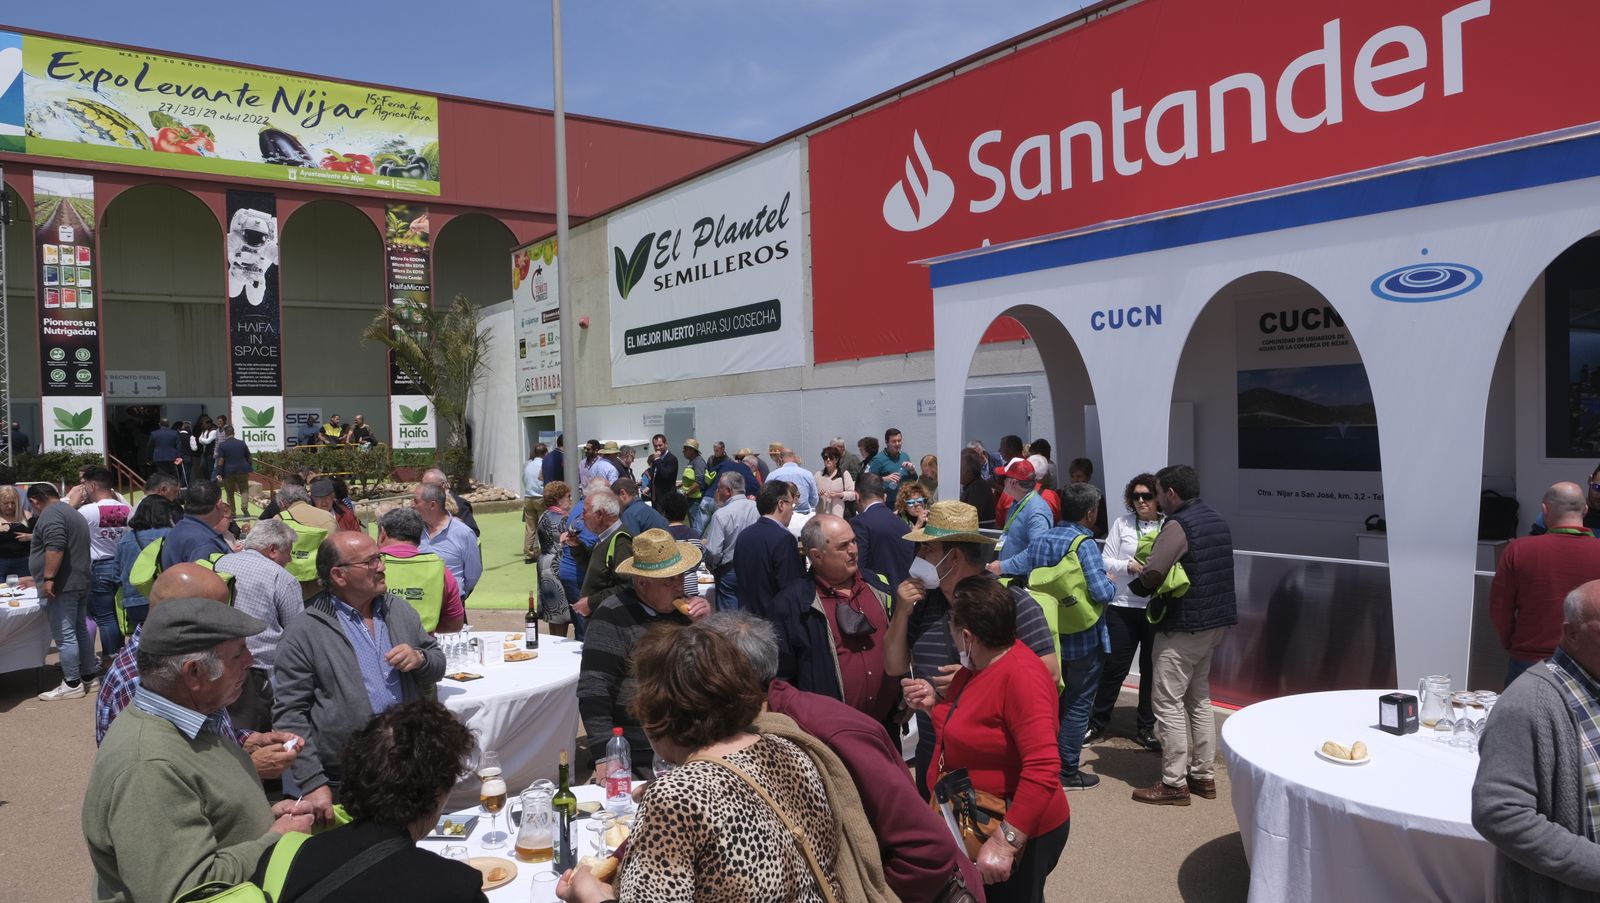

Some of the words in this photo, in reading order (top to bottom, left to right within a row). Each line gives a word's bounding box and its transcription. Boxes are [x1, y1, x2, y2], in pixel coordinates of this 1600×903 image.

[382, 96, 407, 109] Feria
[409, 101, 421, 111] de
[968, 0, 1491, 214] Santander
[219, 112, 241, 121] abril
[242, 113, 270, 126] 2022
[372, 104, 432, 122] Agricultura
[300, 169, 341, 180] Ayuntamiento
[653, 228, 682, 270] El
[692, 191, 791, 260] Plantel
[653, 240, 789, 292] SEMILLEROS
[43, 317, 84, 327] Pioneros
[1090, 304, 1162, 331] CUCN
[1259, 306, 1345, 334] CUCN
[43, 326, 97, 337] Nutrigación
[237, 322, 274, 333] HAIFA
[627, 336, 636, 349] EL
[636, 330, 661, 347] MEJOR
[662, 324, 695, 342] INJERTO
[696, 319, 718, 337] PARA
[719, 316, 731, 332] SU
[732, 308, 777, 330] COSECHA
[250, 334, 262, 345] IN
[1261, 337, 1296, 346] COMUNIDAD
[1305, 333, 1336, 342] USUARIOS
[234, 345, 278, 357] SPACE
[1258, 344, 1277, 352] AGUAS
[1294, 341, 1321, 350] COMARCA
[530, 373, 561, 392] ENTRADA
[241, 430, 276, 442] Haifa
[399, 427, 429, 439] Haifa
[53, 433, 94, 447] Haifa
[1300, 490, 1315, 498] San
[1338, 491, 1352, 500] km.
